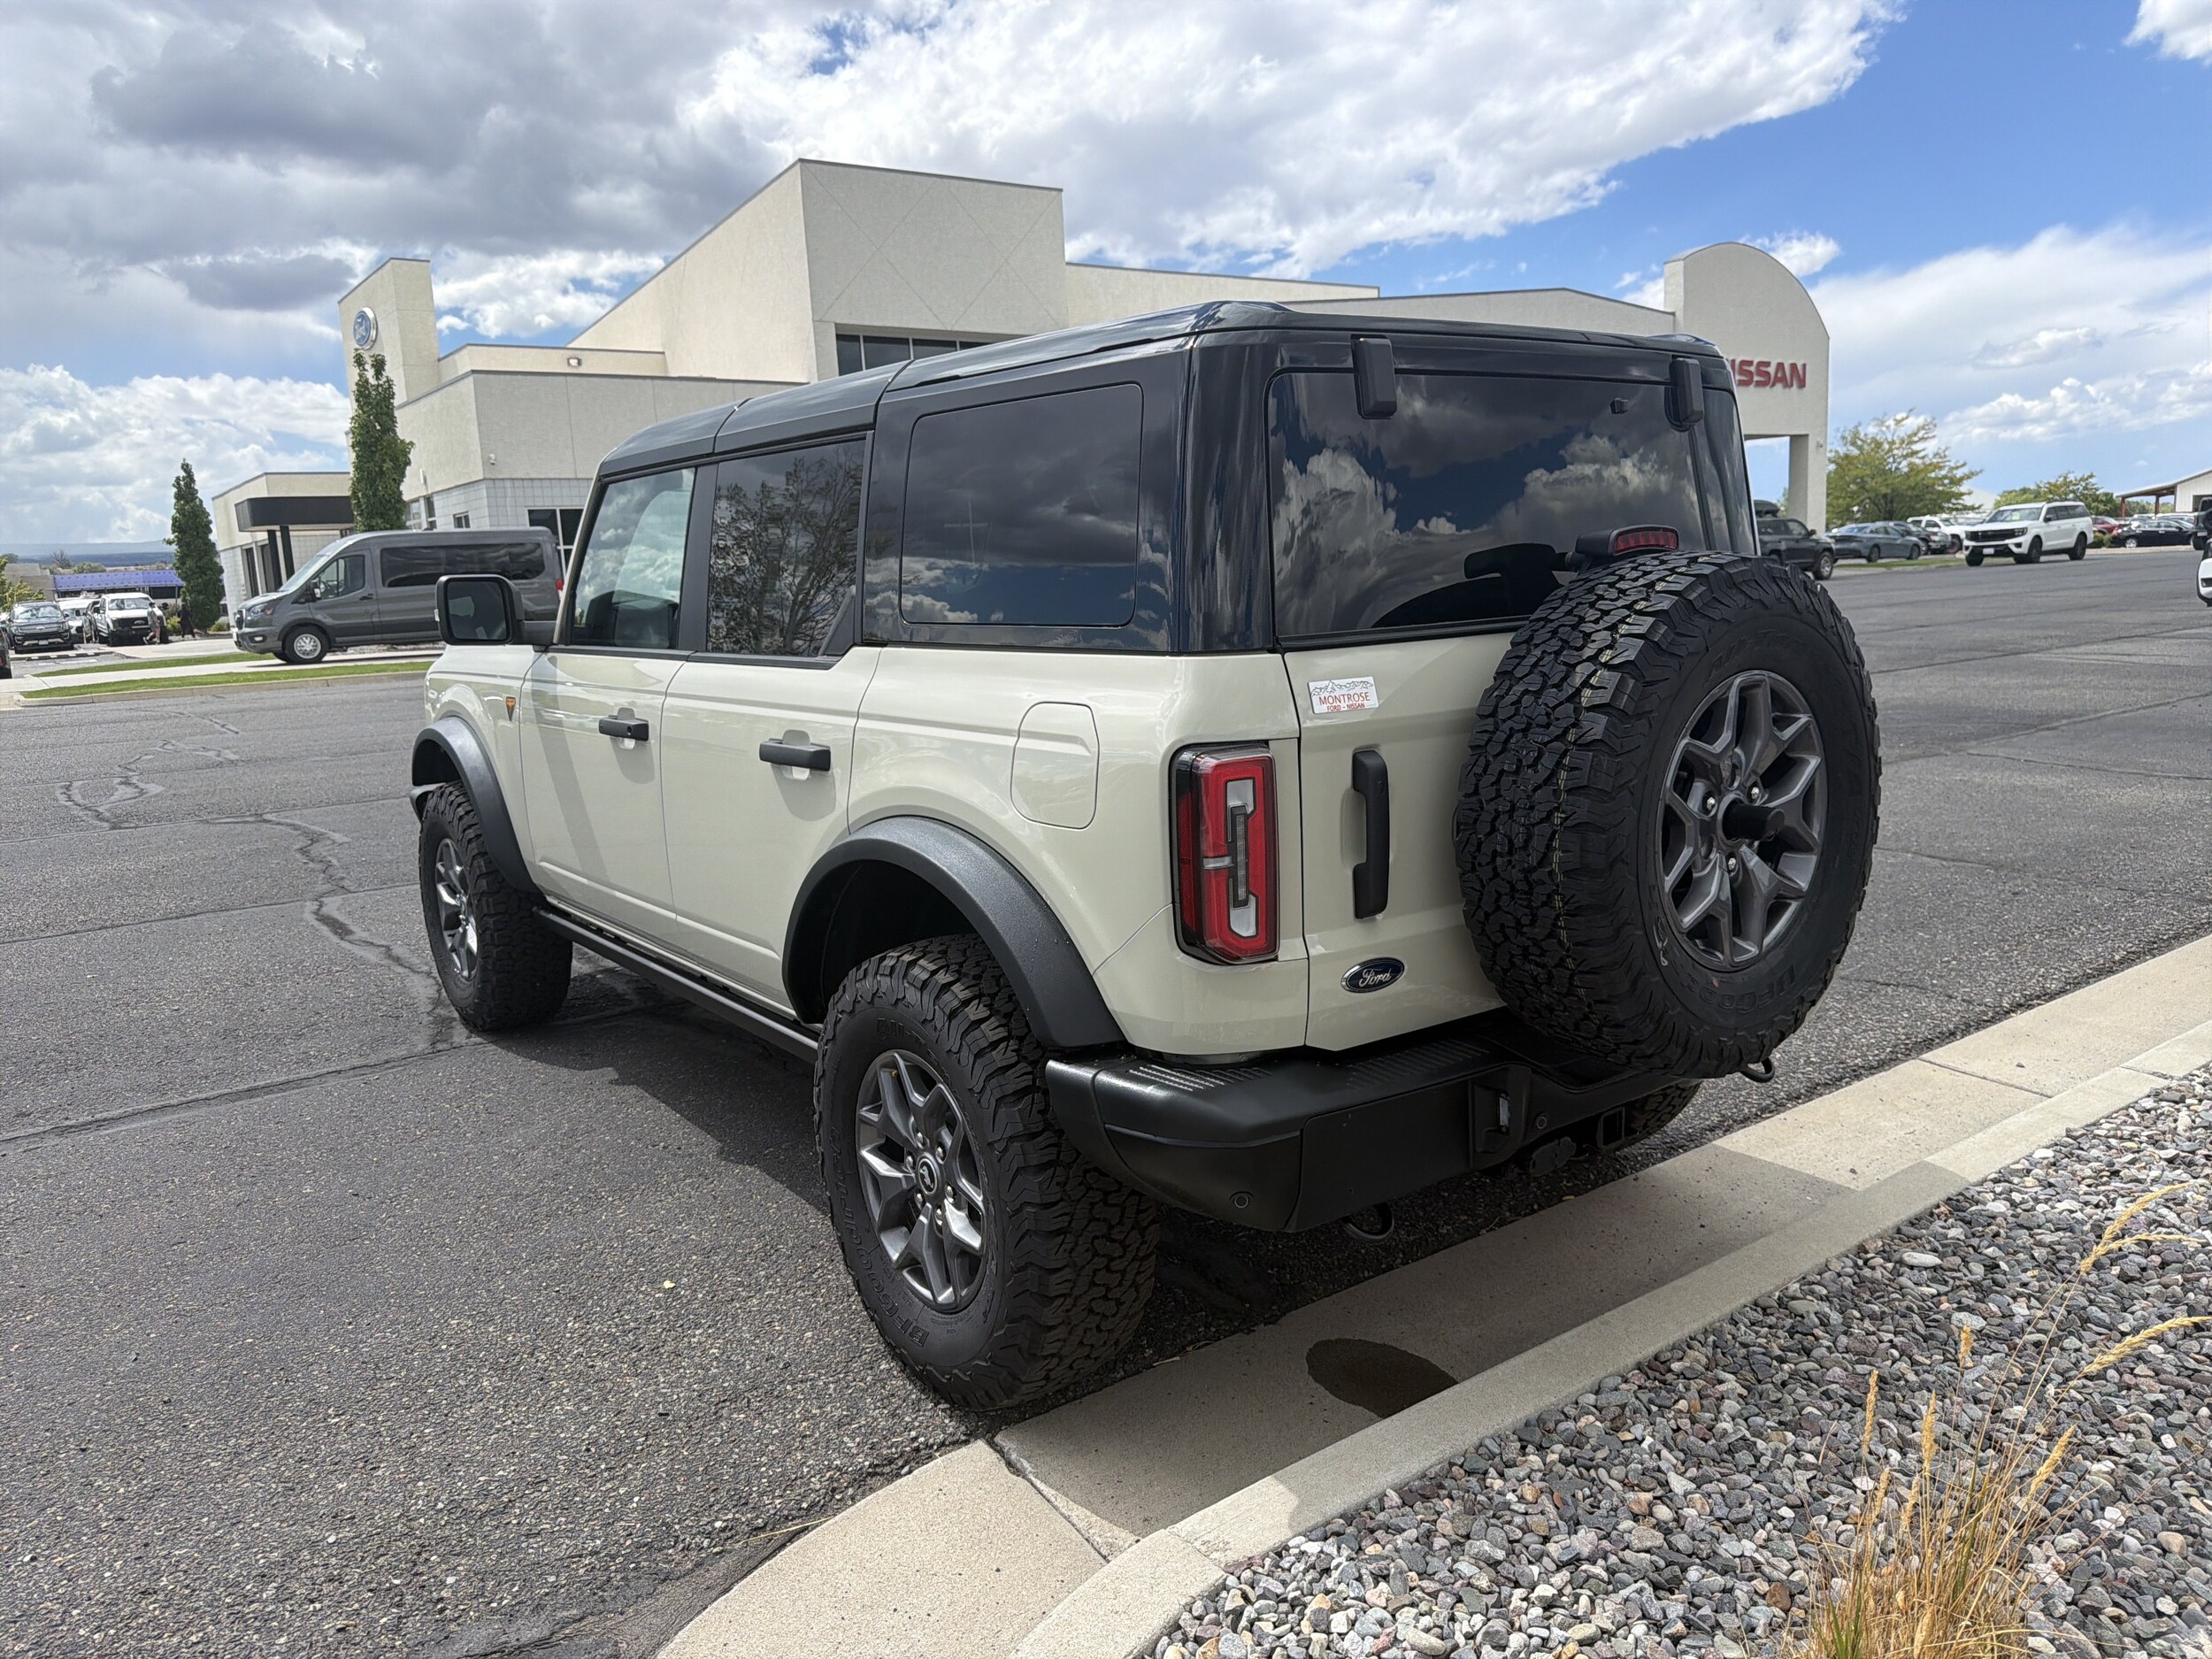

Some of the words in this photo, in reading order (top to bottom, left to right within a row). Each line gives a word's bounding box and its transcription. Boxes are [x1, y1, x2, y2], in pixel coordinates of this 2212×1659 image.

[1728, 358, 1807, 388] ISSAN
[1318, 691, 1371, 706] MONTROSE
[1358, 967, 1392, 987] Ford
